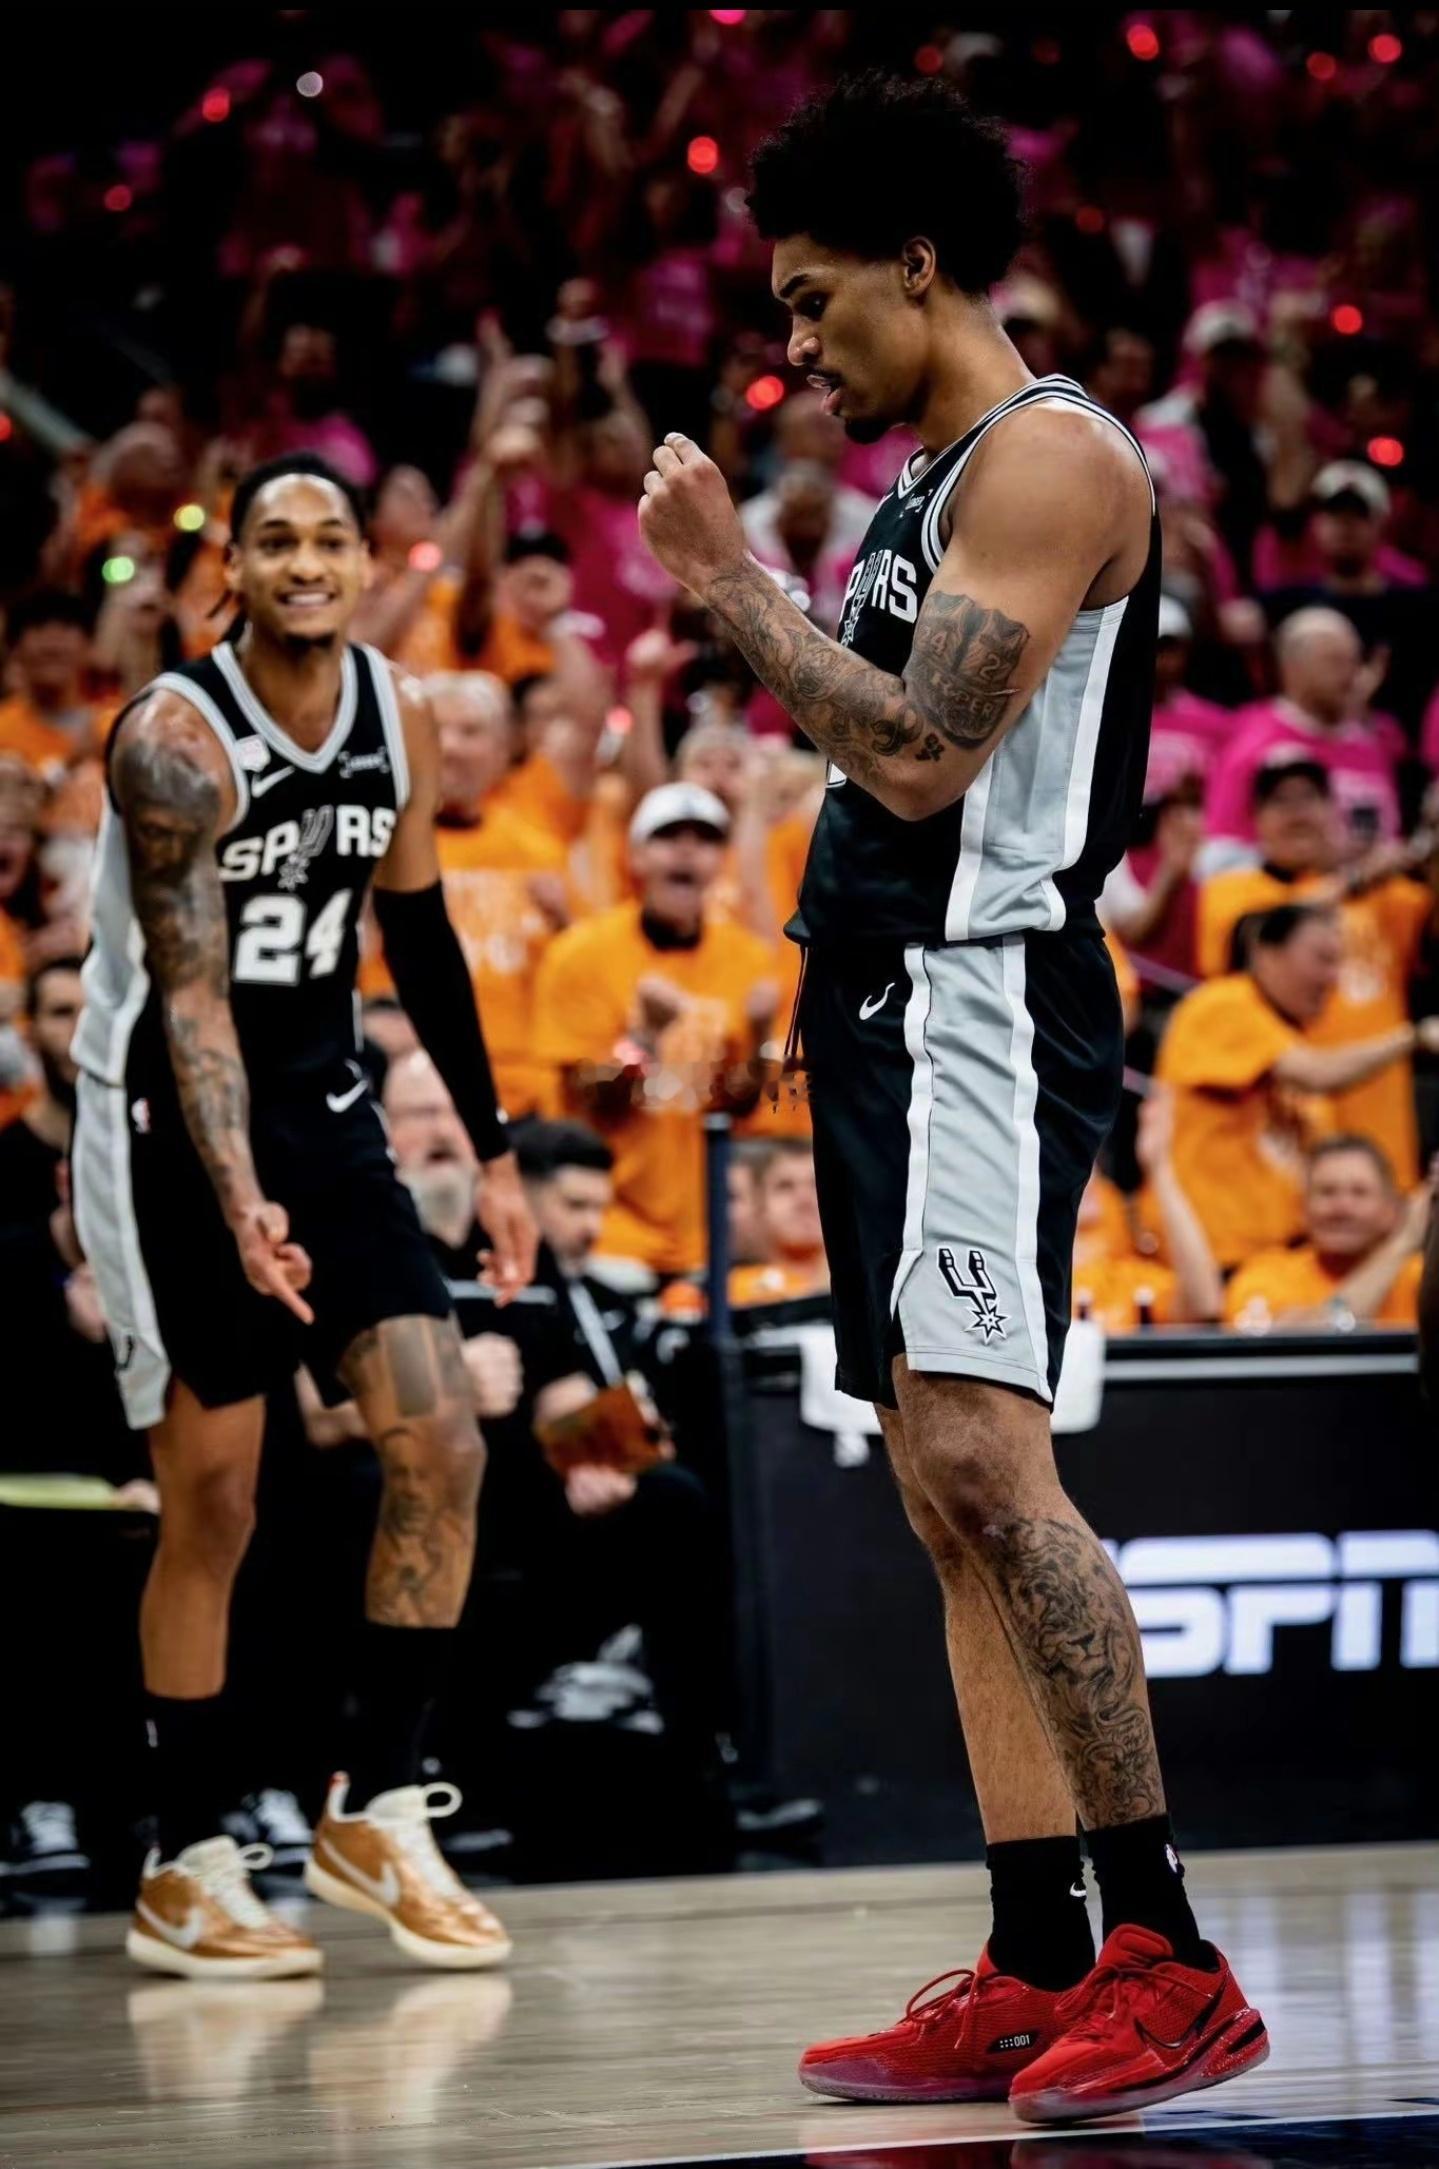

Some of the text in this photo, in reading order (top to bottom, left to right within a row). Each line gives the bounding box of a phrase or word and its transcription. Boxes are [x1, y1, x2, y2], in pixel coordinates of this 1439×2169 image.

[839, 549, 918, 636] PURS
[218, 804, 396, 889] SPURS
[235, 888, 352, 985] 24
[1099, 1529, 1439, 1678] SPN
